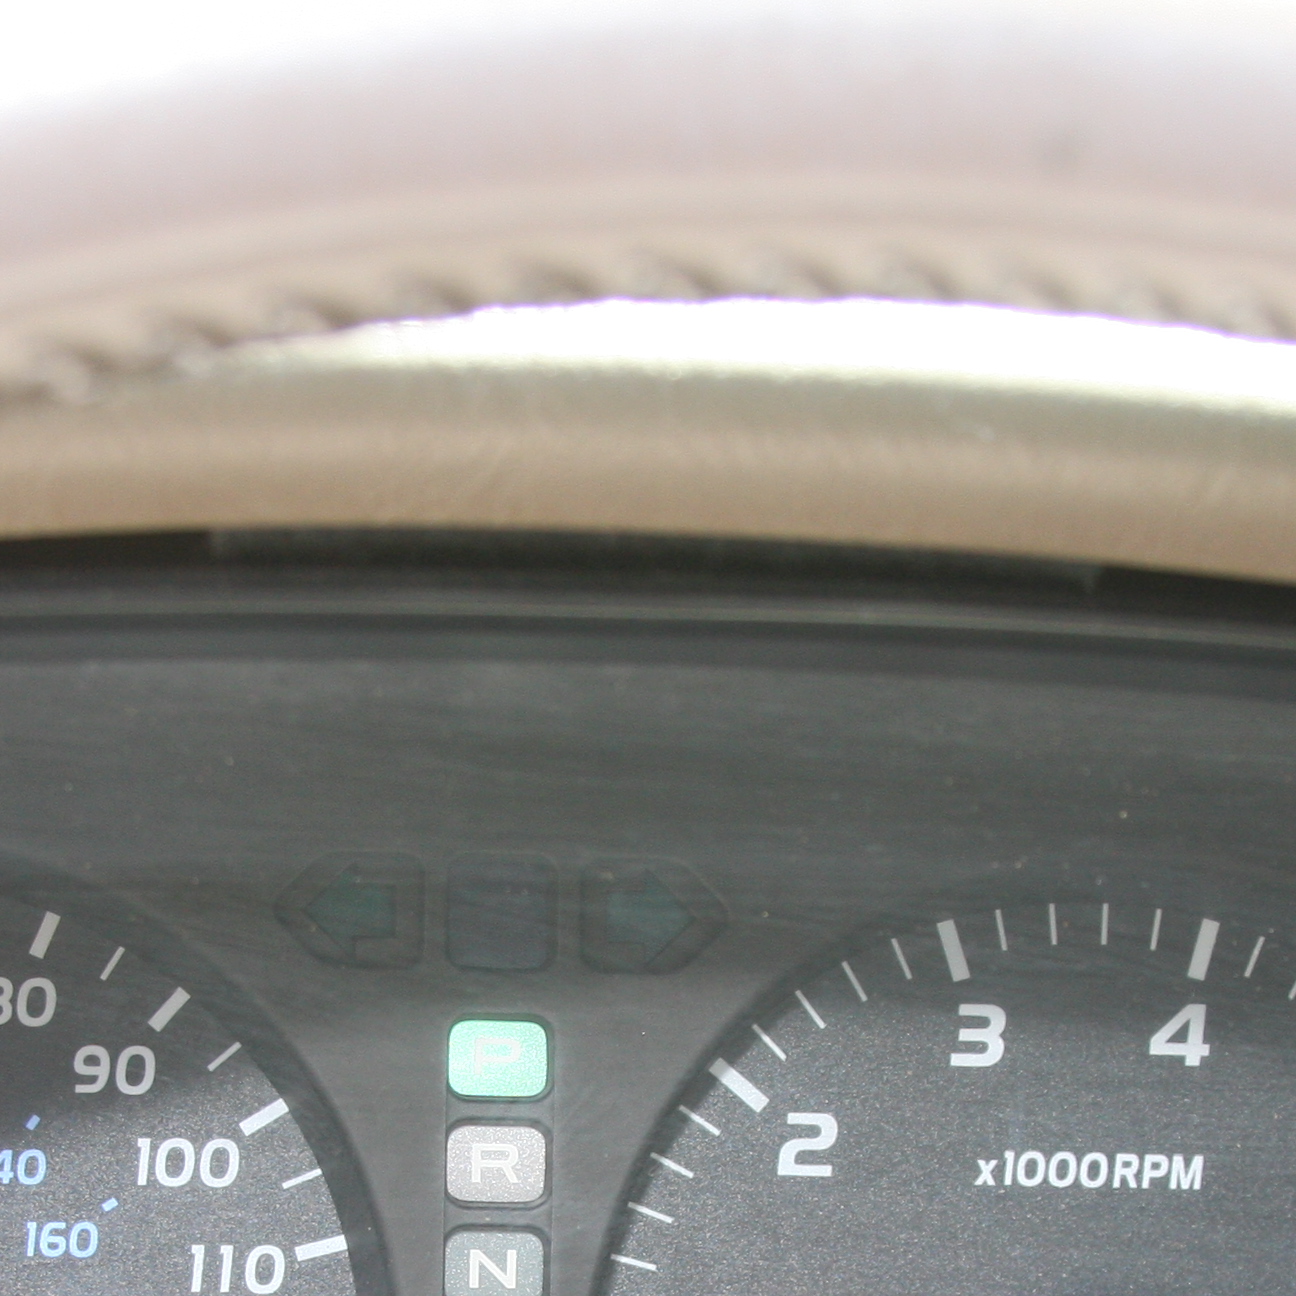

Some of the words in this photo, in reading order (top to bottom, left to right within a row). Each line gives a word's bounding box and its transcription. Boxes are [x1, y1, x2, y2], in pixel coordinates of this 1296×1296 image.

[474, 1037, 522, 1076] P
[950, 1005, 1005, 1067] 3
[1149, 1005, 1210, 1067] 4
[74, 1045, 155, 1095] 90
[137, 1138, 239, 1188] 100
[471, 1142, 520, 1184] R
[777, 1113, 838, 1176] 2
[26, 1221, 98, 1258] 160
[191, 1245, 285, 1294] 110
[469, 1249, 517, 1288] N
